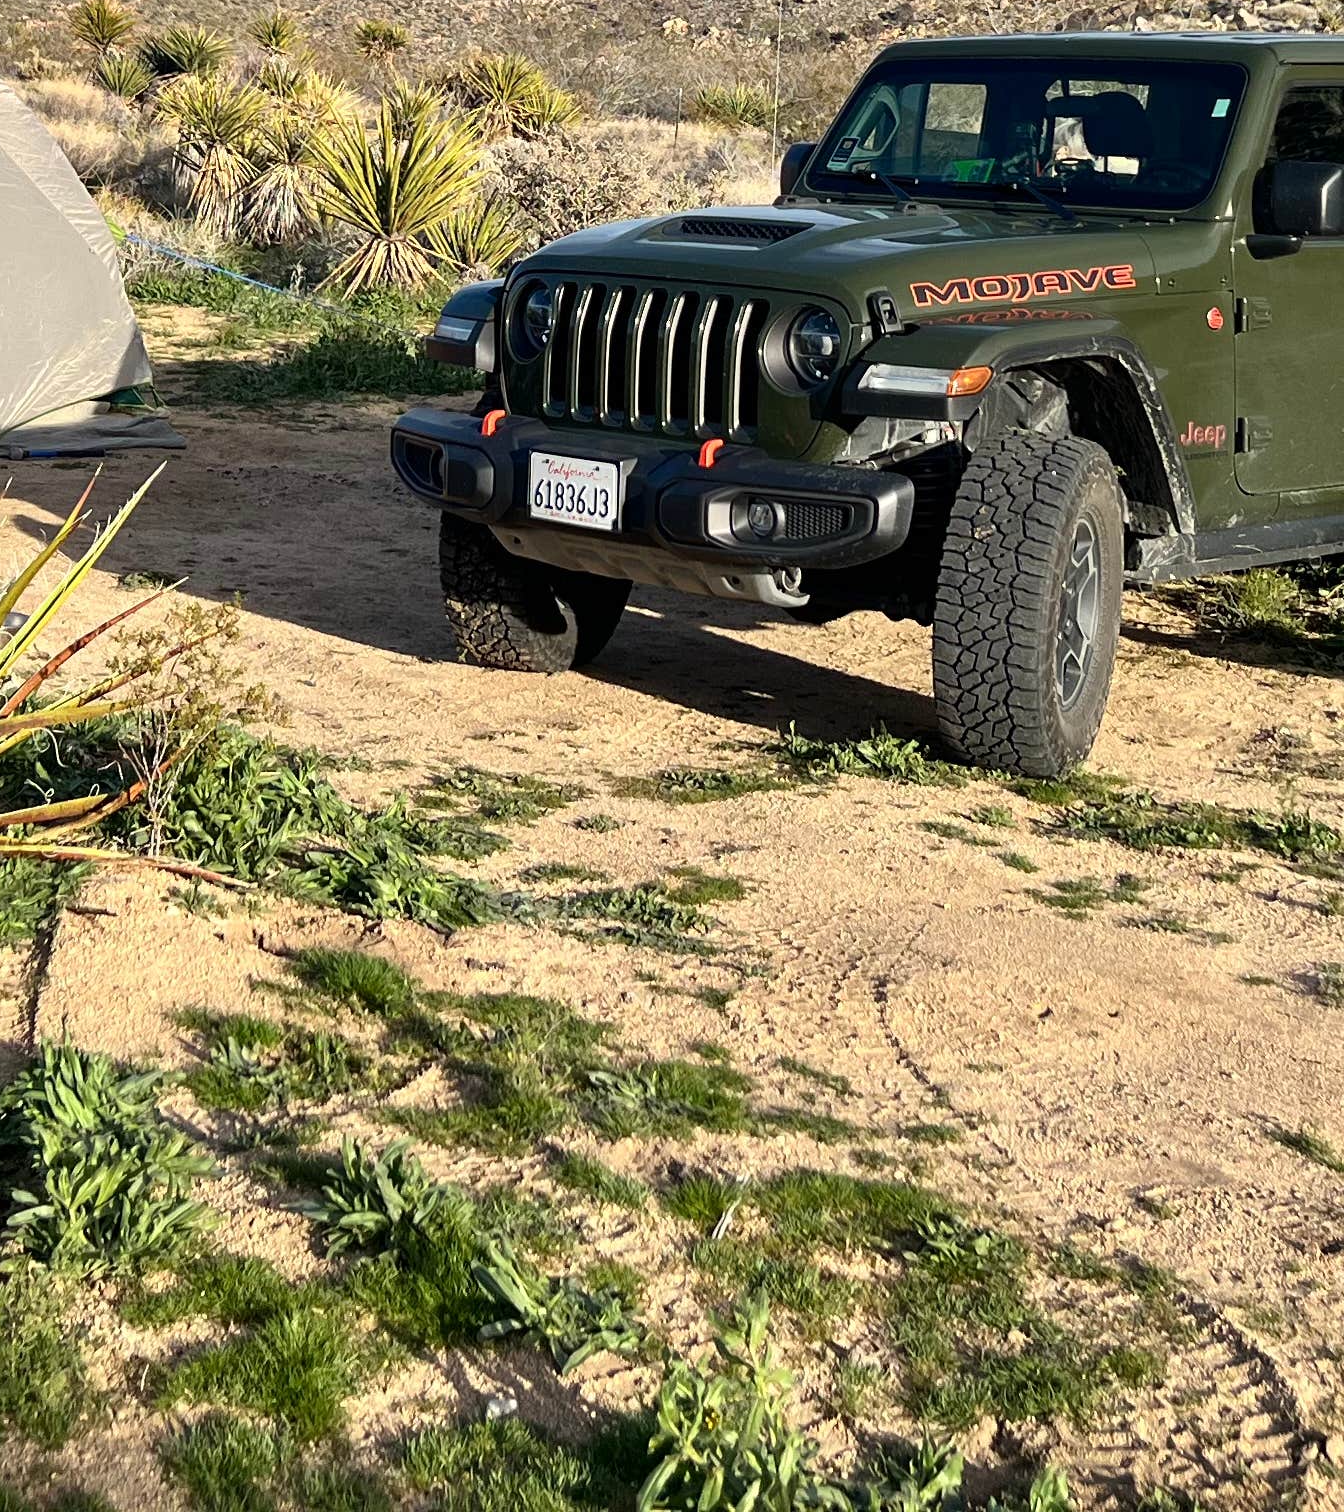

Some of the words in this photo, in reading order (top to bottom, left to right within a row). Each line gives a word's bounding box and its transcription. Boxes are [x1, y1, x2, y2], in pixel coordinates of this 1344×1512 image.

[910, 264, 1136, 307] MOJAVE
[1180, 420, 1226, 450] Jeep
[547, 460, 597, 480] California
[534, 479, 609, 518] 61836J3
